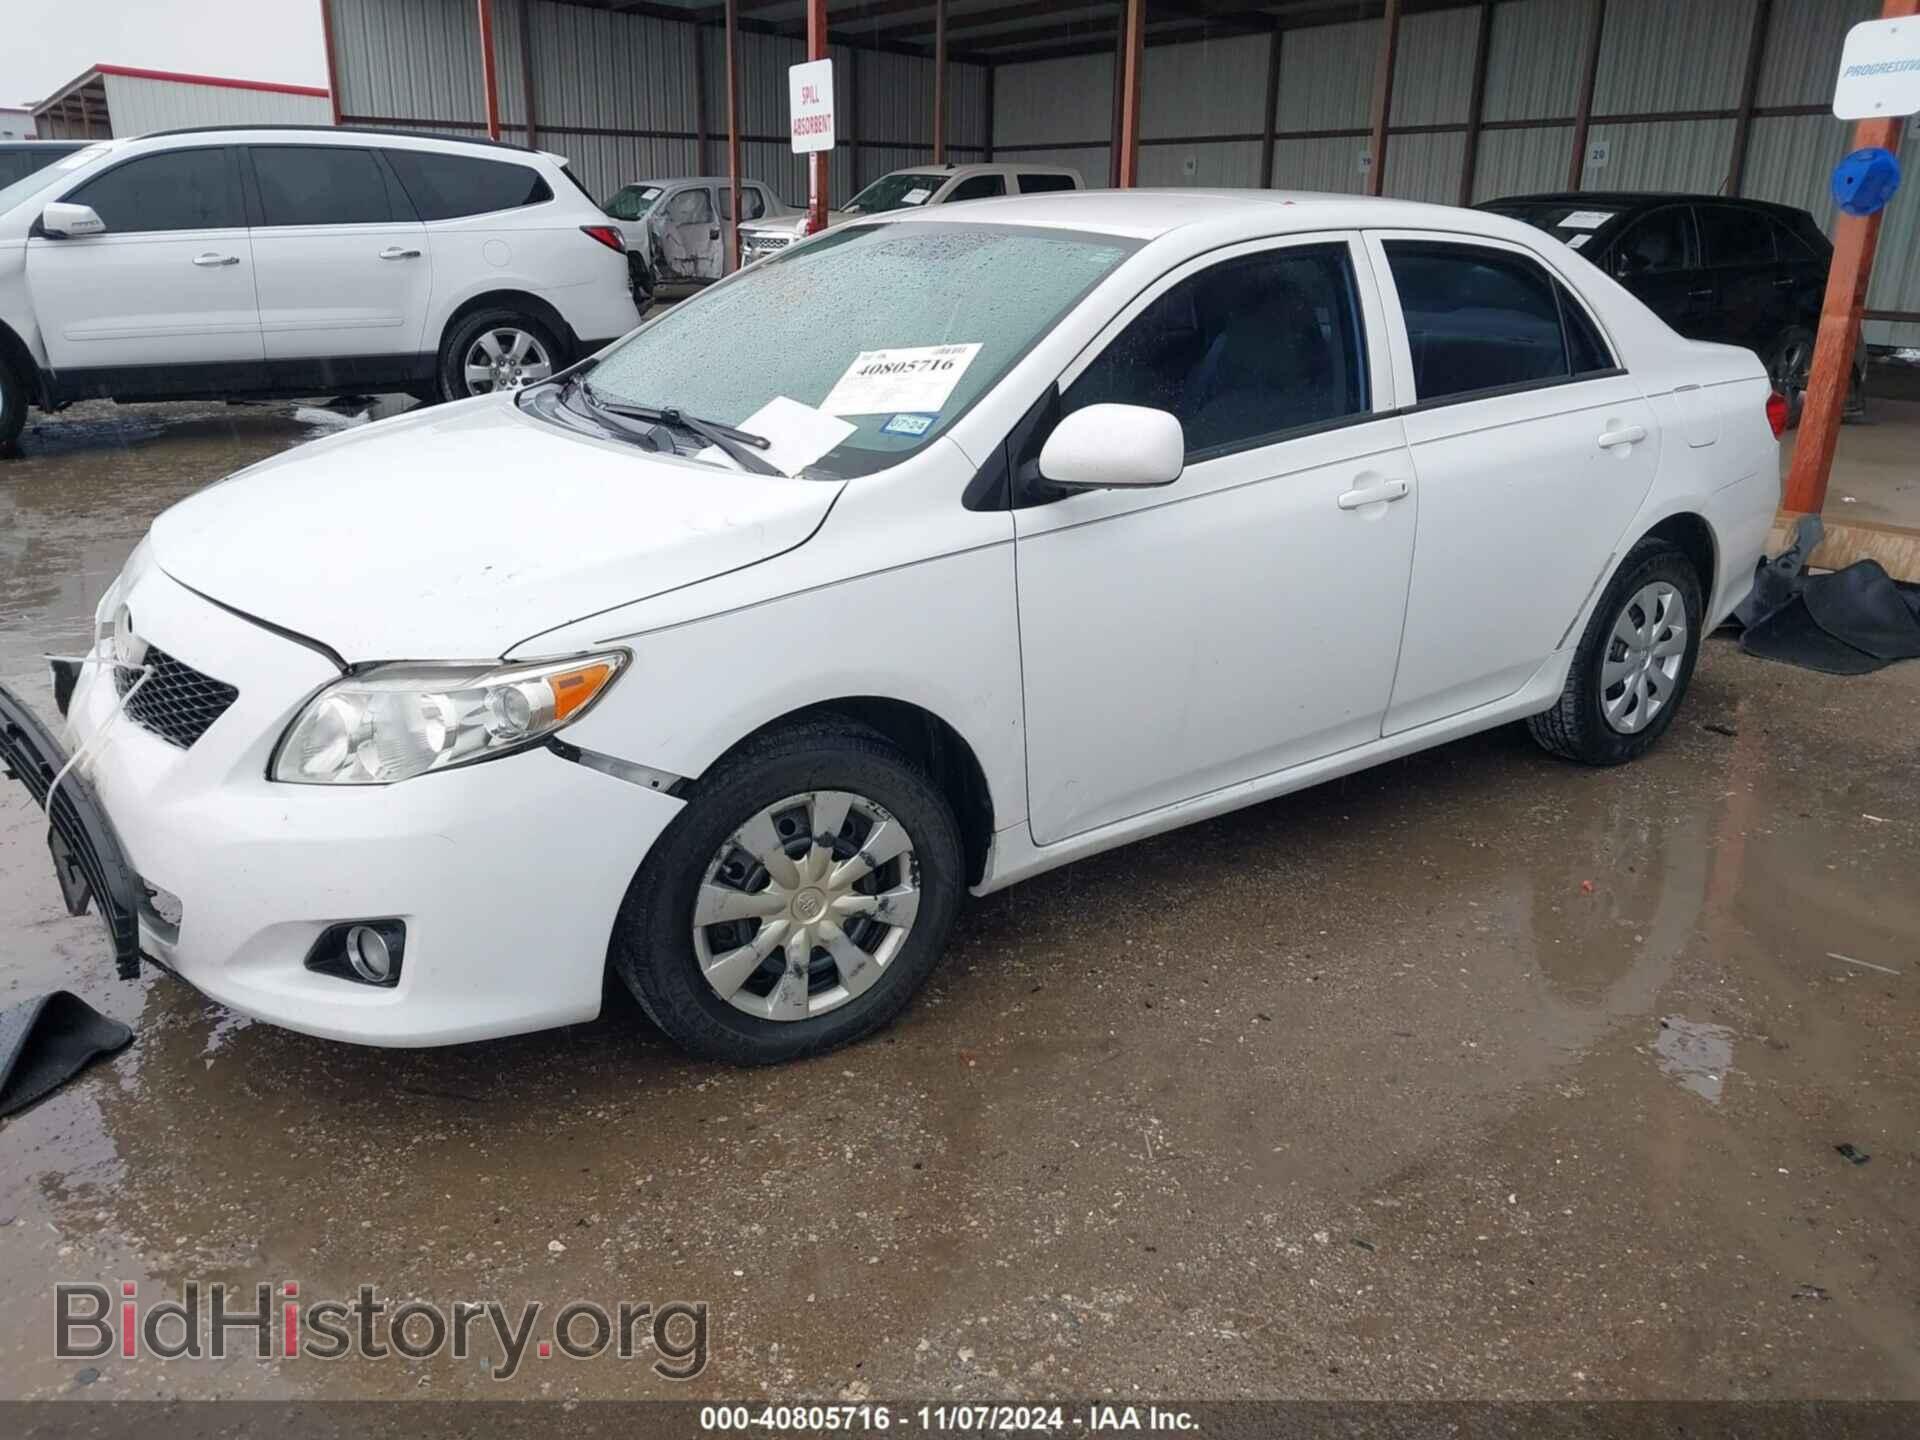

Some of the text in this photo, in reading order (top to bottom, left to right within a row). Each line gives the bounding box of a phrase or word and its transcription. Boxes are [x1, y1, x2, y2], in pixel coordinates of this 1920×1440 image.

[801, 84, 820, 105] SPILL
[793, 114, 832, 136] ABSORBENT
[857, 359, 954, 376] 40805716
